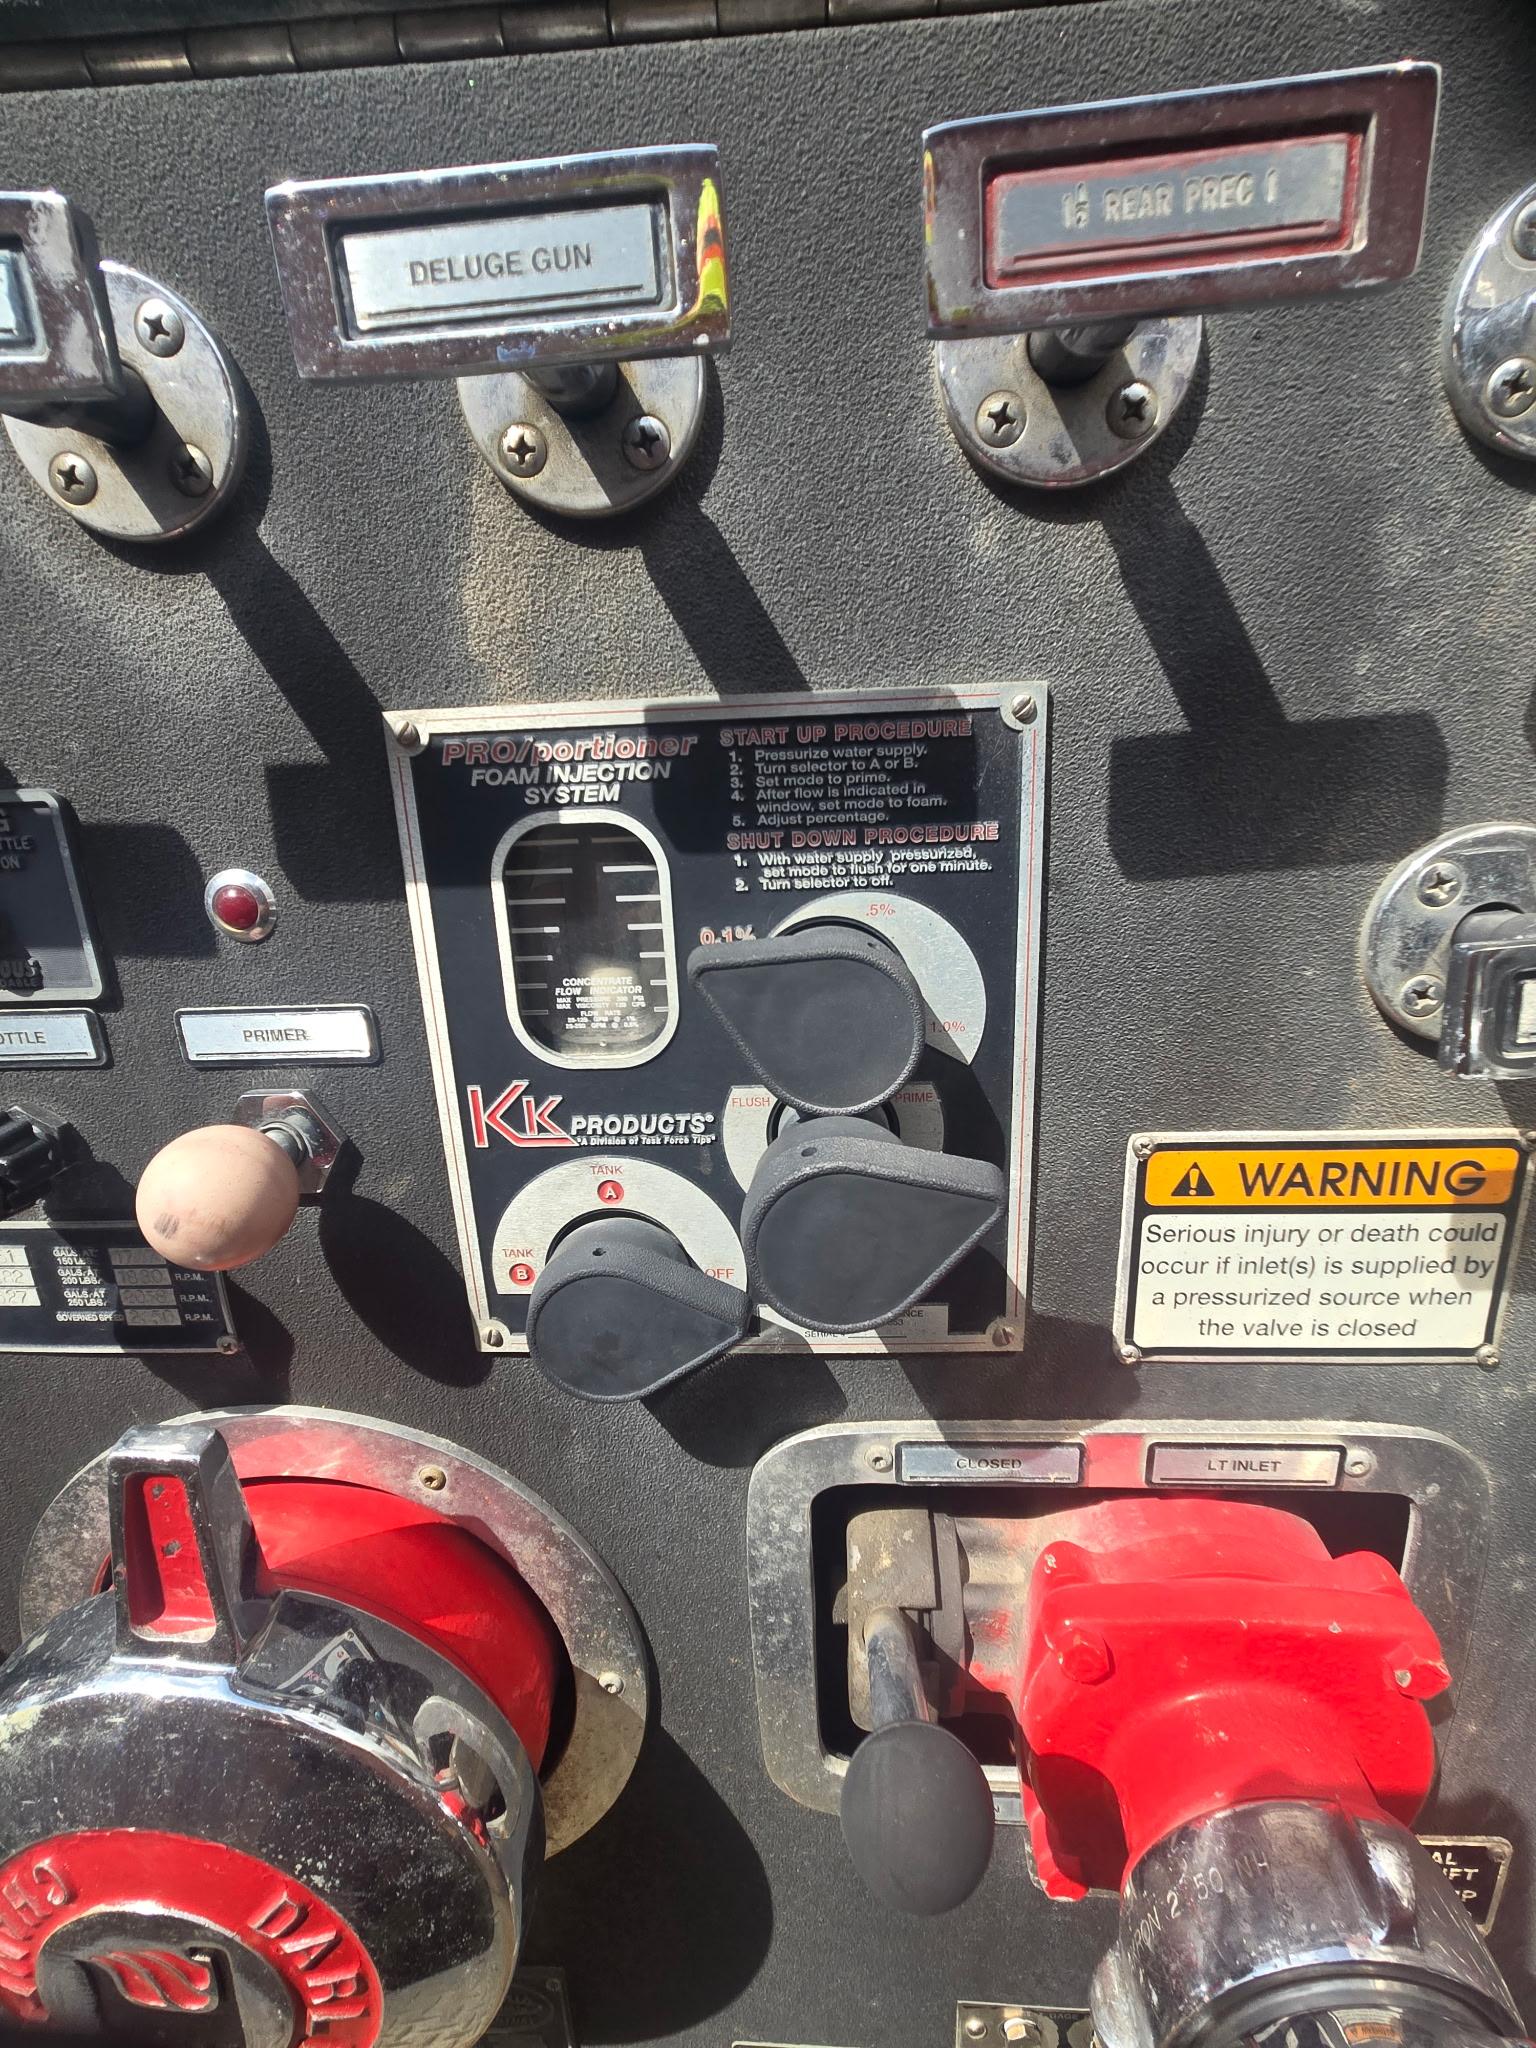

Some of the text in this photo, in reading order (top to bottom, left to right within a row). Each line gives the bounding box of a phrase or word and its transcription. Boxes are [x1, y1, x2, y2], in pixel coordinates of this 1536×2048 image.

[1103, 182, 1174, 222] REAR
[1183, 171, 1255, 215] PREC
[408, 243, 592, 286] DELUGE GUN
[719, 719, 972, 747] START UP PROCEDURE
[442, 732, 698, 767] PRO/portioner
[729, 744, 928, 763] 1. Pressurize water supply.
[471, 761, 672, 787] FOAM INJECTION
[729, 757, 918, 776] 2. Turn selector to A or B.
[730, 771, 891, 789] 3. Set mode to prime.
[524, 783, 621, 805] SYSTEM
[730, 783, 925, 802] 4. After flow is indicated in
[757, 794, 948, 814] window, set mode to foam.
[732, 811, 889, 828] 5. Adjust percentage.
[727, 822, 999, 851] SHUT DOWN PROCEDURE
[734, 854, 748, 868] 1.
[758, 852, 791, 866] With
[794, 852, 834, 866] water
[836, 850, 883, 866] supply
[763, 859, 993, 878] set mode to flush for one minute.
[735, 879, 749, 892] 2.
[760, 878, 791, 891] Turn
[794, 876, 850, 890] selector
[853, 876, 868, 888] to
[866, 904, 895, 917] .5%
[562, 976, 633, 987] CONCENTRATE
[555, 985, 643, 996] FLOW INDICATOR
[243, 1028, 307, 1042] PRIMER
[928, 1021, 966, 1033] 1.0%
[731, 1096, 771, 1108] FLUSH
[589, 1136, 627, 1147] Division
[629, 1136, 639, 1146] of
[642, 1135, 662, 1146] Task
[664, 1135, 690, 1146] Force
[590, 1165, 624, 1176] TANK
[1238, 1160, 1487, 1198] WARNING
[604, 1186, 617, 1199] A
[1146, 1222, 1499, 1248] Serious injury or death could
[502, 1248, 534, 1259] TANK
[516, 1268, 530, 1280] B
[704, 1268, 735, 1279] OFF
[1140, 1255, 1496, 1279] occur if inlet(s) is supplied by
[62, 1277, 78, 1285] 200
[68, 1299, 83, 1307] 250
[1152, 1287, 1473, 1309] a pressurized source when
[56, 1312, 98, 1322] GOVERNED
[1198, 1318, 1417, 1336] the valve is closed
[956, 1457, 1022, 1470] CLOSED
[1207, 1459, 1282, 1472] LT INLET
